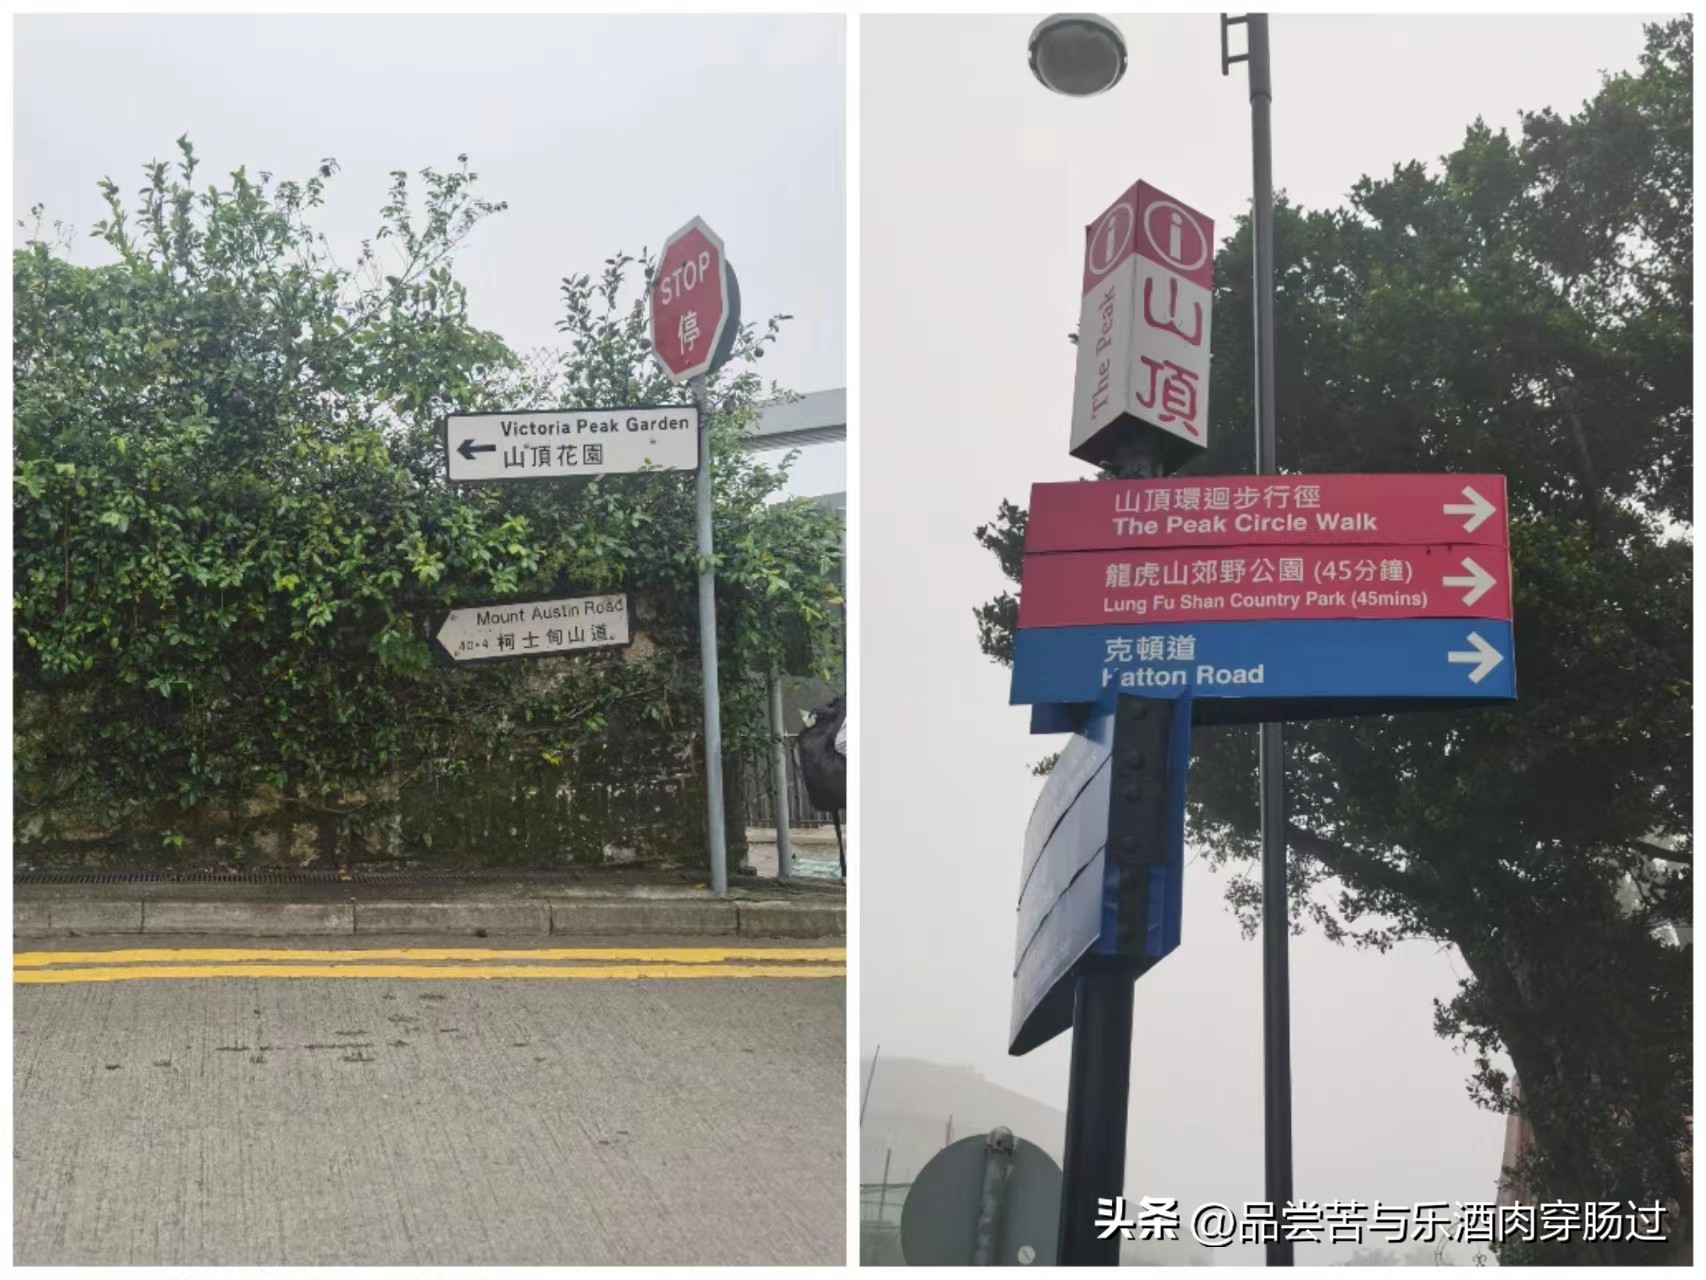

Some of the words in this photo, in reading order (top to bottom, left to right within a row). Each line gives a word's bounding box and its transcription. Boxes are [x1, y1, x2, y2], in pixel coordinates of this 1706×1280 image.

[660, 250, 710, 305] STOP
[678, 310, 700, 355] 停
[1096, 284, 1115, 354] Peak
[1136, 276, 1203, 437] 山頂
[1091, 360, 1111, 421] The
[501, 420, 570, 438] Victoria
[577, 418, 619, 434] Peak
[626, 416, 689, 432] Garden
[504, 443, 603, 468] 山頂花園
[1115, 485, 1321, 513] 山頂環迴步行徑
[1112, 517, 1158, 536] The
[1166, 515, 1227, 534] Peak
[1234, 513, 1307, 532] Circle
[1316, 512, 1377, 531] Walk
[1105, 557, 1303, 588] 龍虎山郊野公園
[1314, 559, 1413, 585] (45分鐘)
[477, 610, 525, 626] Mount
[531, 604, 580, 620] Austin
[584, 599, 624, 615] Road
[1103, 597, 1147, 614] Lung
[1153, 595, 1175, 611] Fu
[1180, 594, 1224, 609] Shan
[1230, 592, 1300, 610] Country
[1306, 591, 1346, 606] Park
[1351, 590, 1428, 609] (45mins)
[497, 624, 609, 651] 柯士甸山道
[1104, 634, 1196, 662] 克頓道
[1196, 664, 1264, 685] Road
